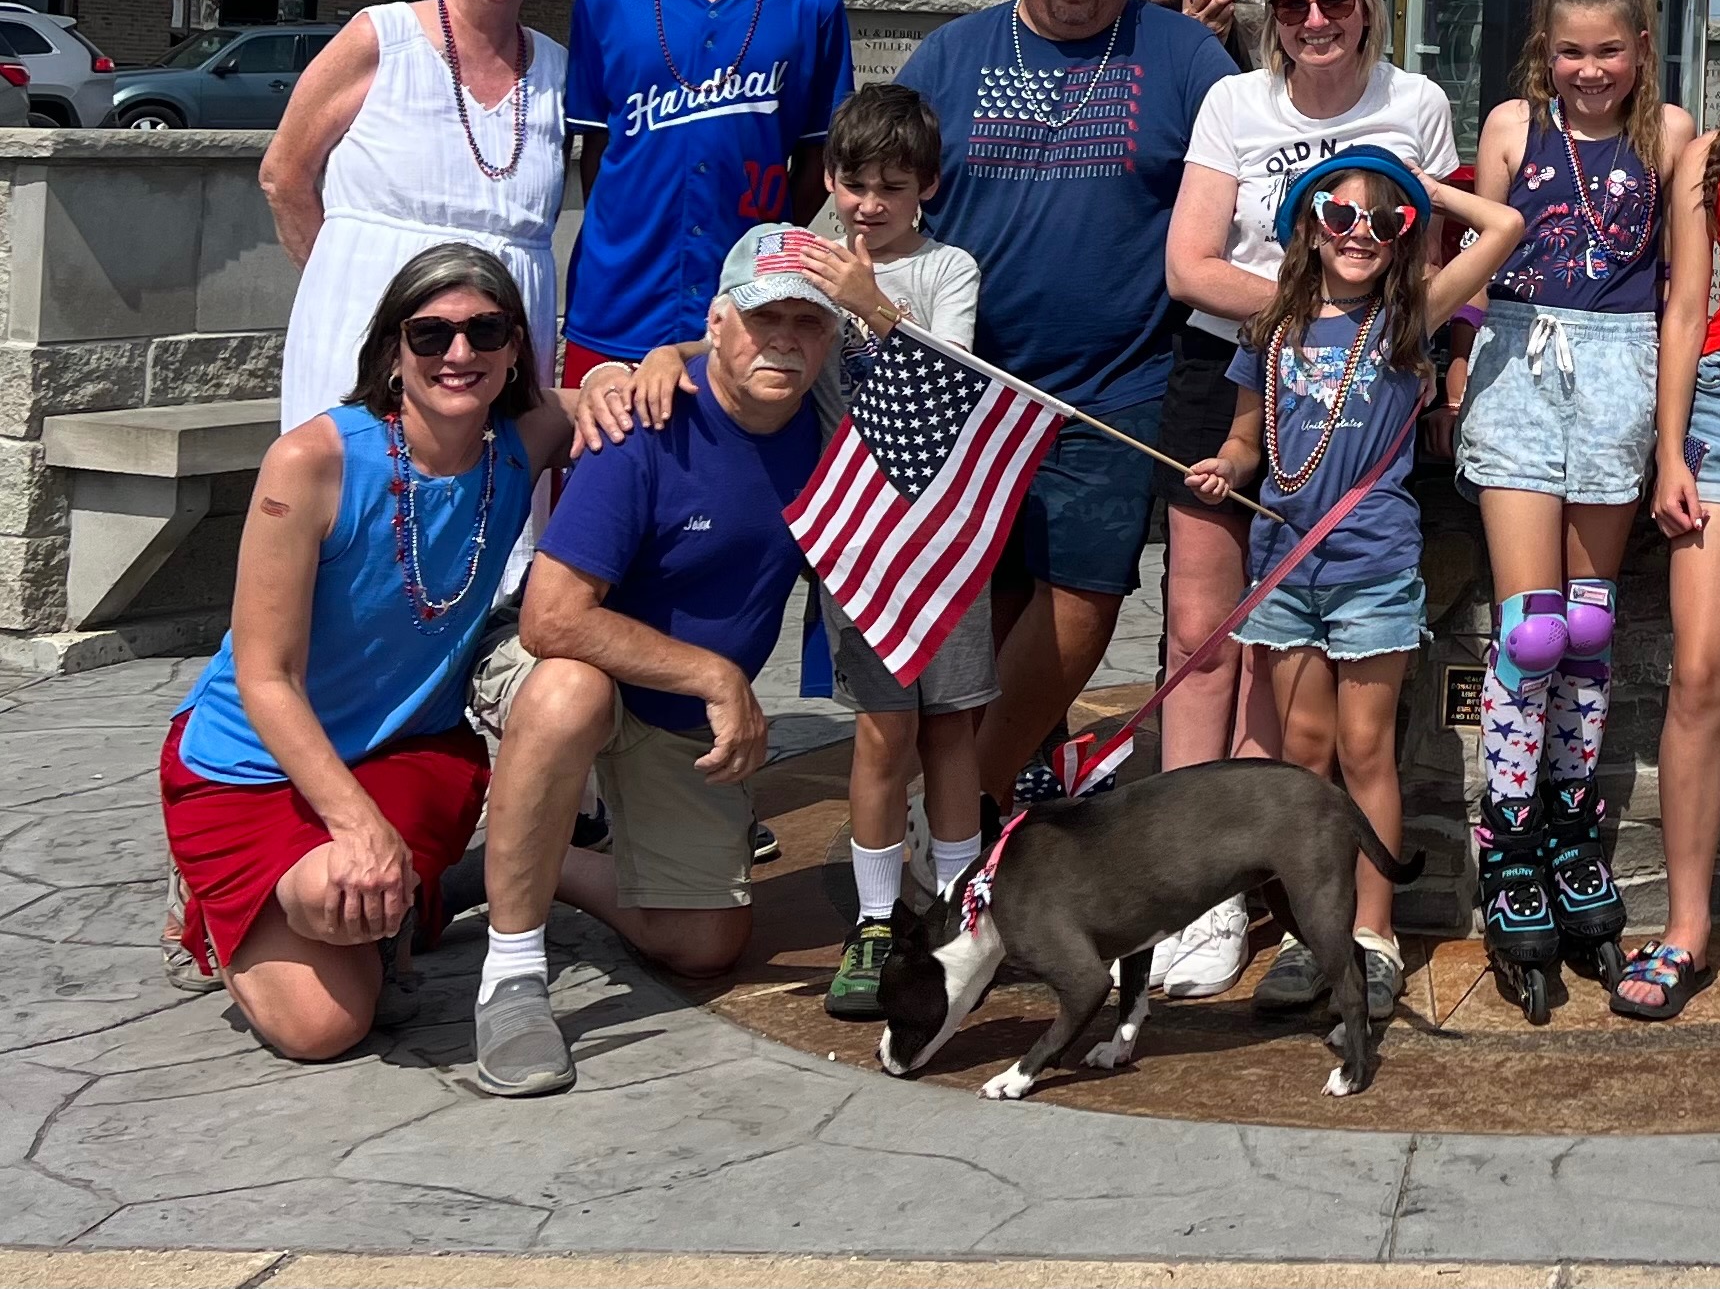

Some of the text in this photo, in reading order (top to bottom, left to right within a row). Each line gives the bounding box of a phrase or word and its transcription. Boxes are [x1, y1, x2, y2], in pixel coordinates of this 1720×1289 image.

[884, 30, 923, 40] DEBBIE
[865, 41, 912, 52] STILLER
[625, 61, 789, 137] Hardball
[1265, 141, 1311, 174] OLD
[738, 160, 788, 222] 20
[1301, 419, 1328, 431] Unite
